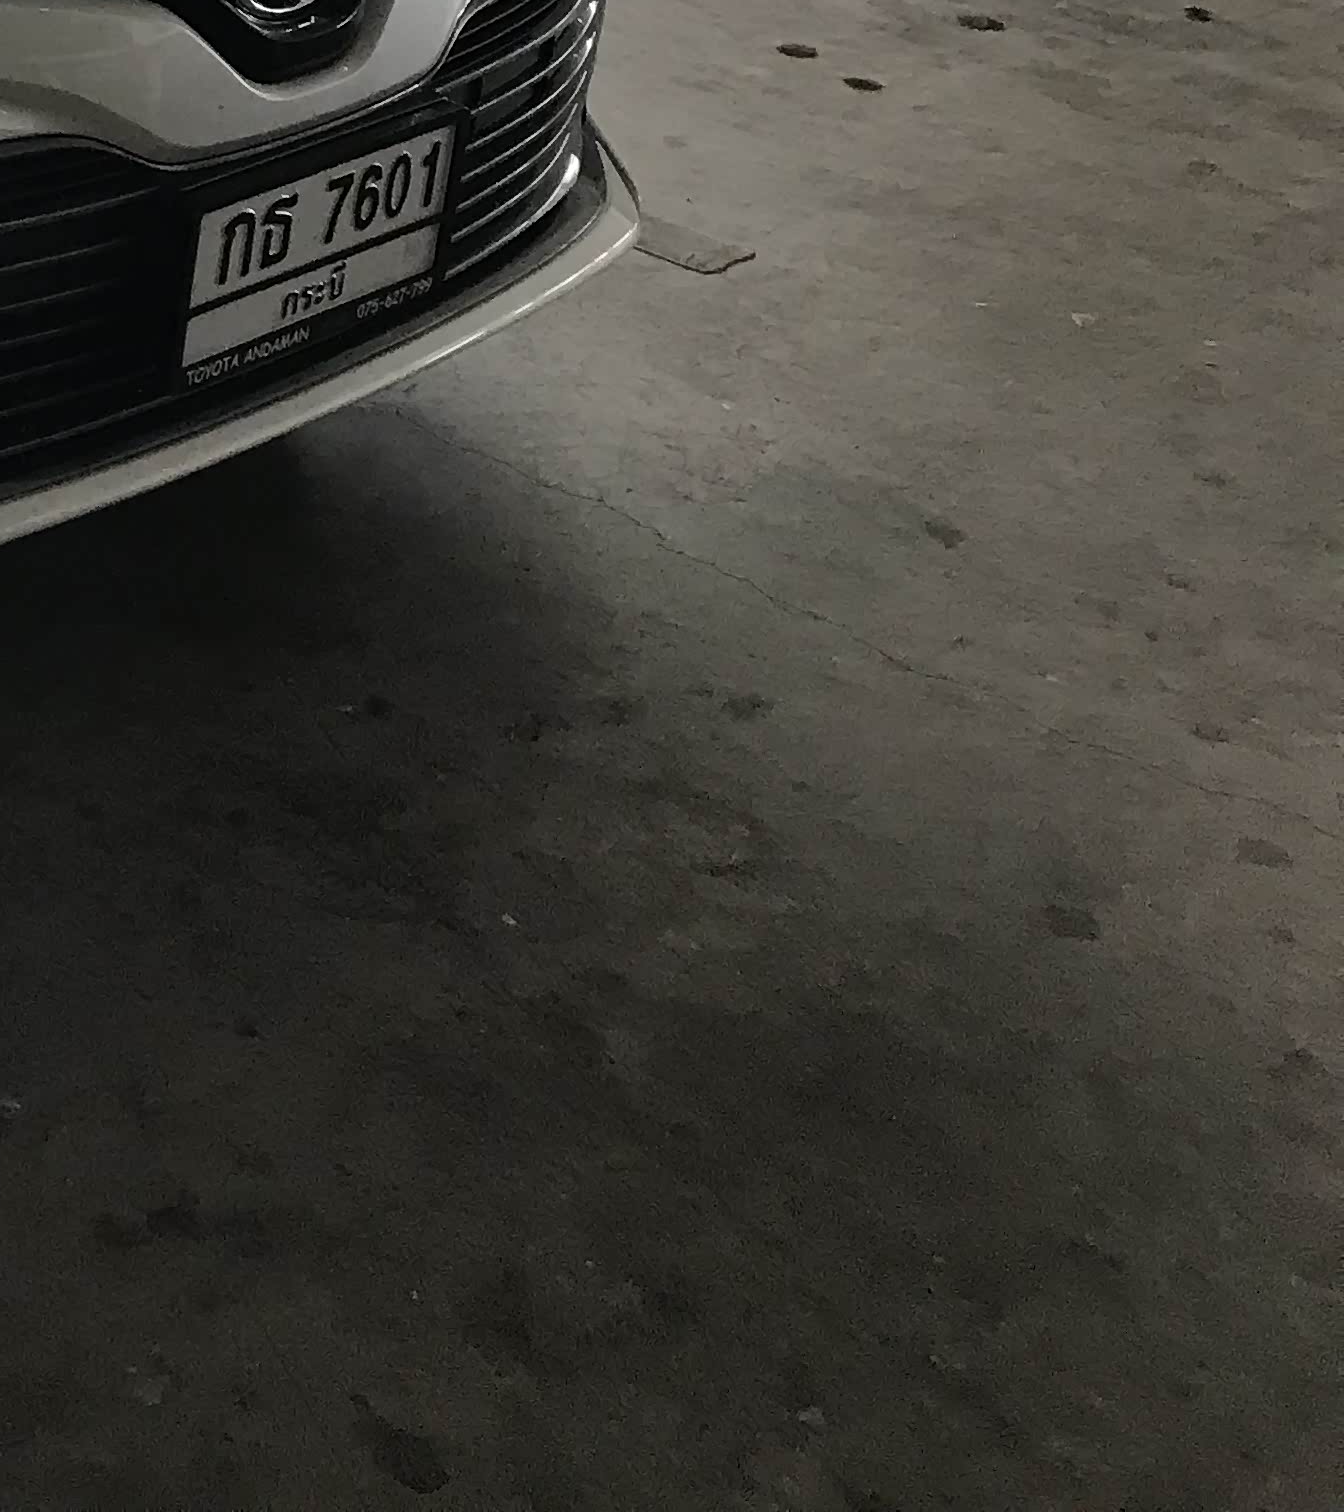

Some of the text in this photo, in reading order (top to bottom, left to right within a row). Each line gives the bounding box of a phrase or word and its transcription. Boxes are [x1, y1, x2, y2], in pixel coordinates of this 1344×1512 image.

[214, 140, 442, 285] กธ 7601
[185, 353, 240, 386] TOYOTA
